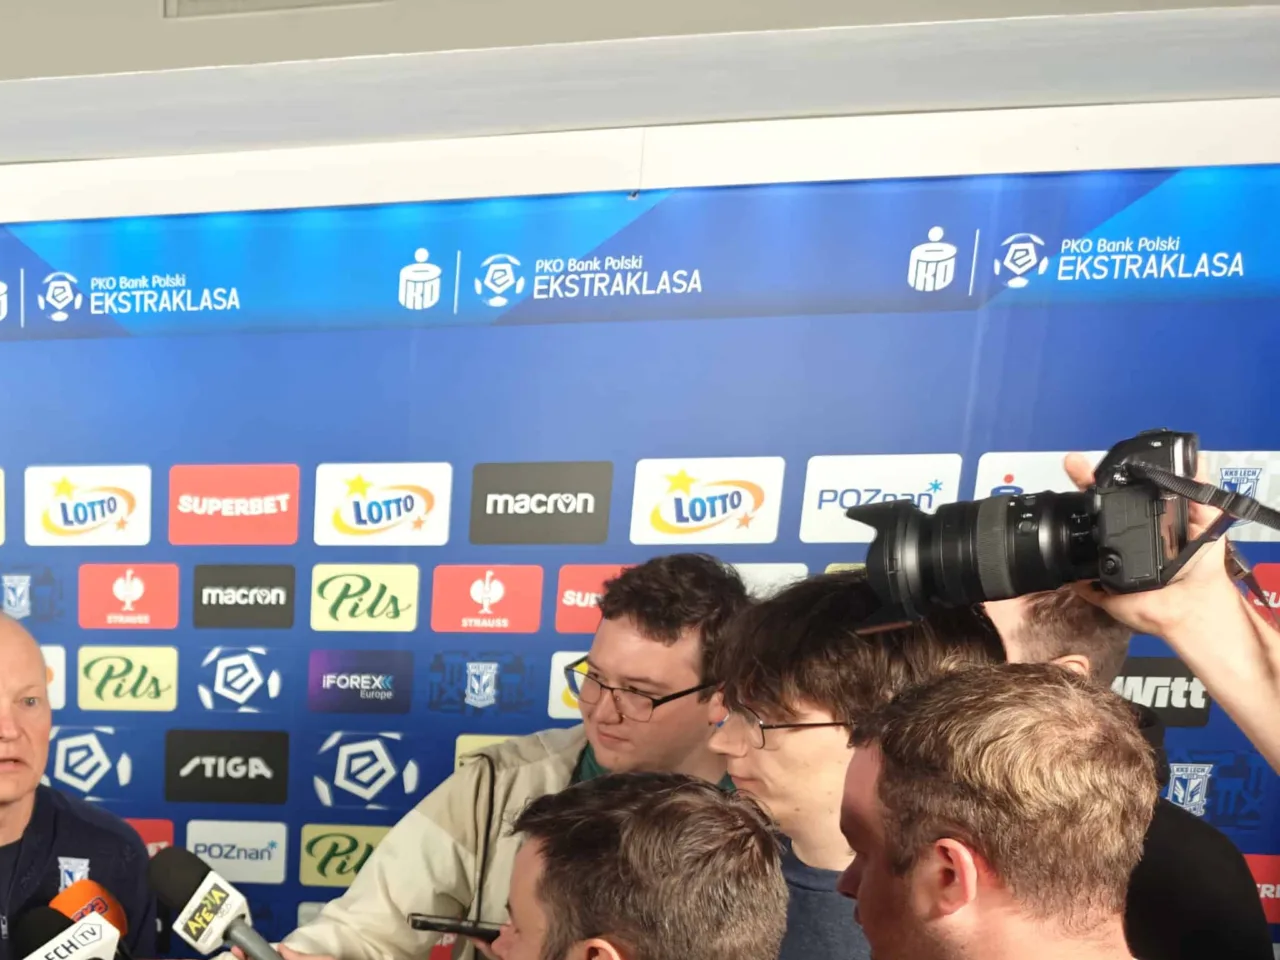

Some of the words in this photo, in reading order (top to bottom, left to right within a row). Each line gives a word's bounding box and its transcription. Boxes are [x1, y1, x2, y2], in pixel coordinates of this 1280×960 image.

[1061, 239, 1092, 253] PKO
[1097, 238, 1133, 253] Bank
[1138, 236, 1180, 252] Polski
[535, 259, 563, 273] PKO
[568, 258, 600, 271] Bank
[605, 255, 642, 270] Polski
[1057, 252, 1244, 281] EKSTRAKLASA
[91, 277, 116, 290] PKO
[120, 276, 149, 289] Bank
[152, 274, 186, 287] Polski
[533, 269, 702, 299] EKSTRAKLASA
[90, 287, 240, 315] EKSTRAKLASA
[60, 497, 117, 526] LOTTO
[177, 493, 290, 516] SUPERBET
[354, 495, 414, 525] LOTTO
[486, 493, 595, 514] macron
[674, 490, 742, 523] LOTTO
[202, 586, 286, 606] macron
[317, 574, 411, 621] Pils
[461, 618, 509, 628] STRAUSS
[83, 656, 171, 700] Pils
[322, 674, 383, 690] iFOREX
[360, 689, 394, 701] Europe
[179, 756, 273, 779] STIGA
[305, 833, 375, 878] Pil
[81, 926, 98, 942] TV
